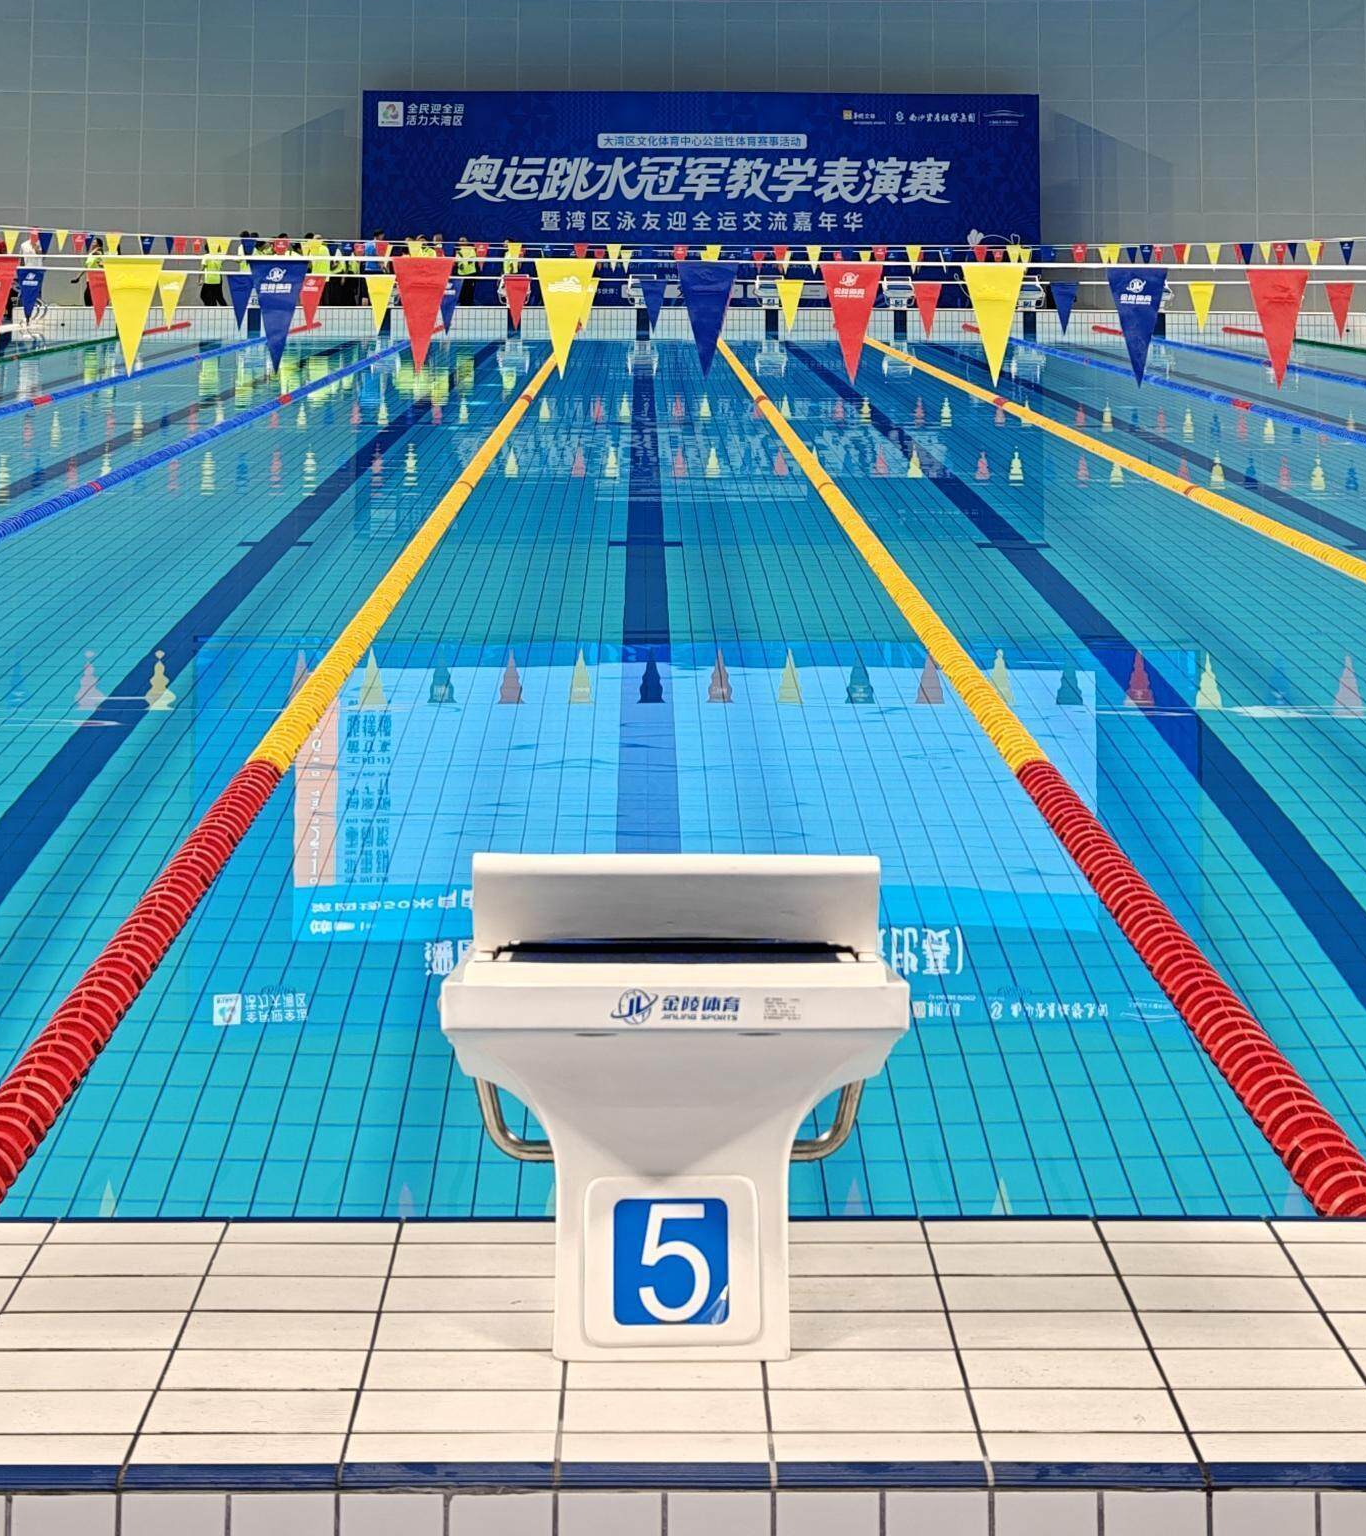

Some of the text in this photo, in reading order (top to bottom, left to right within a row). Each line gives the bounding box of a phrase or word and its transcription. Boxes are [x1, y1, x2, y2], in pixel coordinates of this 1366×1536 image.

[407, 103, 465, 114] 全民迎全运
[406, 115, 463, 126] 活力大湾区
[603, 135, 802, 147] 大湾区文化体育中心公益性体育赛事活动
[451, 154, 953, 205] 奥运跳水冠军教学表演赛
[541, 209, 865, 234] 暨湾区泳友迎全运交流嘉年华
[661, 994, 741, 1013] 金陵体育
[661, 1013, 738, 1021] JINLING SPORTS
[637, 1202, 711, 1322] 5
